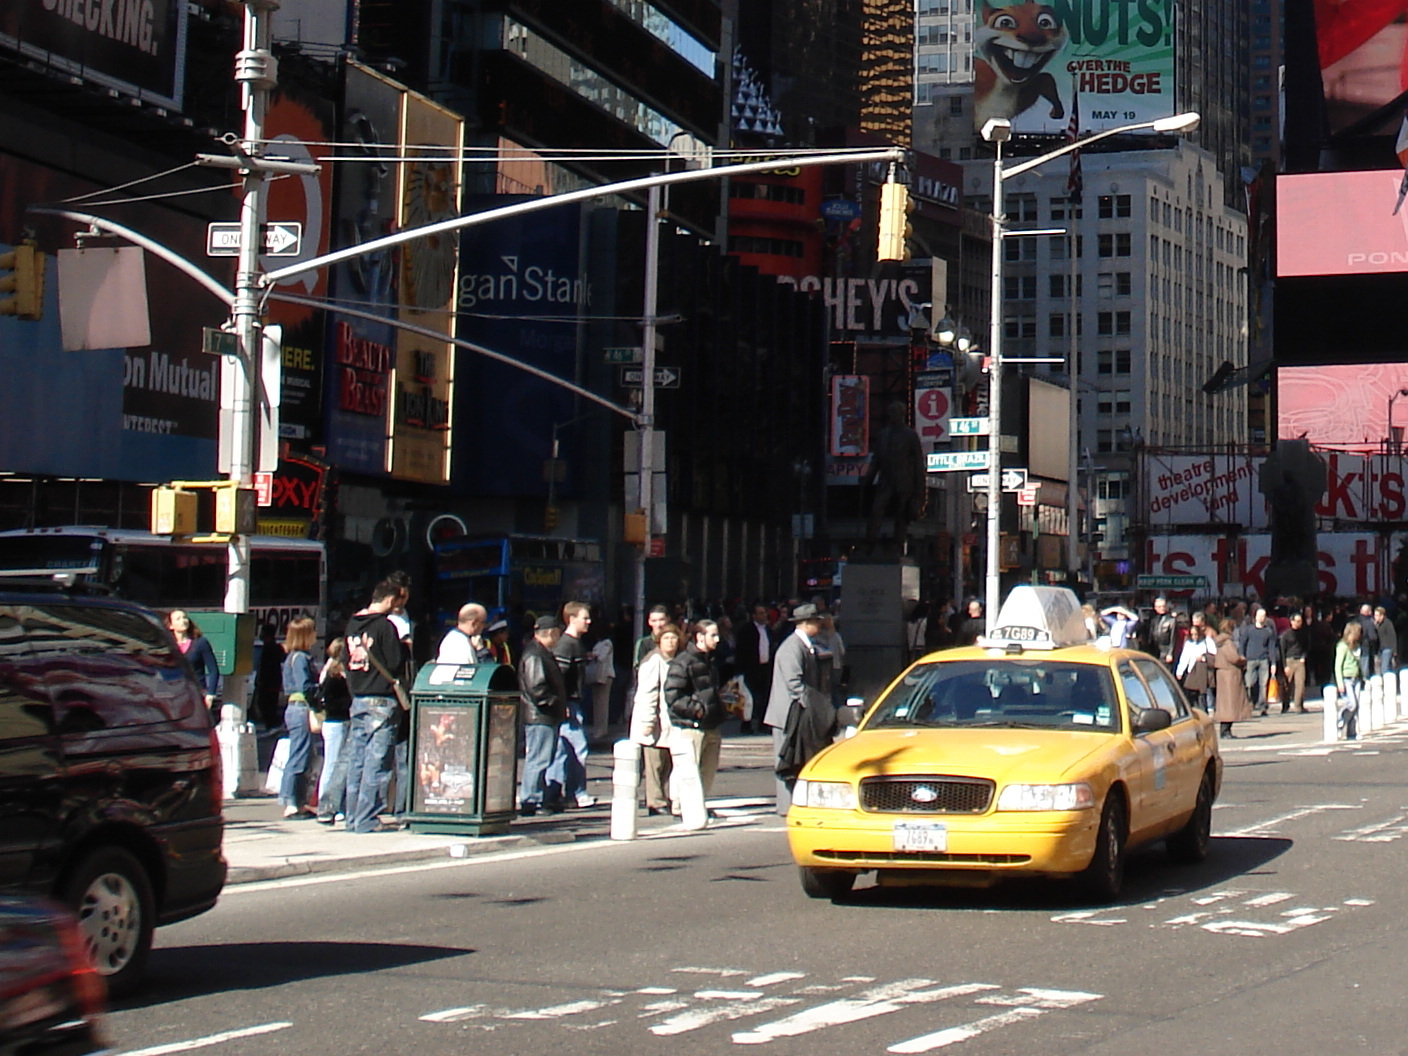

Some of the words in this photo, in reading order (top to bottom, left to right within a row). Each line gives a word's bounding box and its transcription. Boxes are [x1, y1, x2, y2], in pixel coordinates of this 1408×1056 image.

[1066, 60, 1103, 74] OVER
[1103, 59, 1132, 72] THE
[1079, 72, 1162, 95] HEDGE
[1092, 110, 1118, 120] MAY
[1122, 110, 1137, 120] 19
[149, 351, 218, 402] Mutual
[959, 420, 971, 434] 46
[927, 453, 956, 467] LITTLE
[1156, 461, 1213, 492] theatre
[1150, 461, 1256, 513] development
[1203, 490, 1240, 514] fund
[1004, 626, 1035, 641] 7G89
